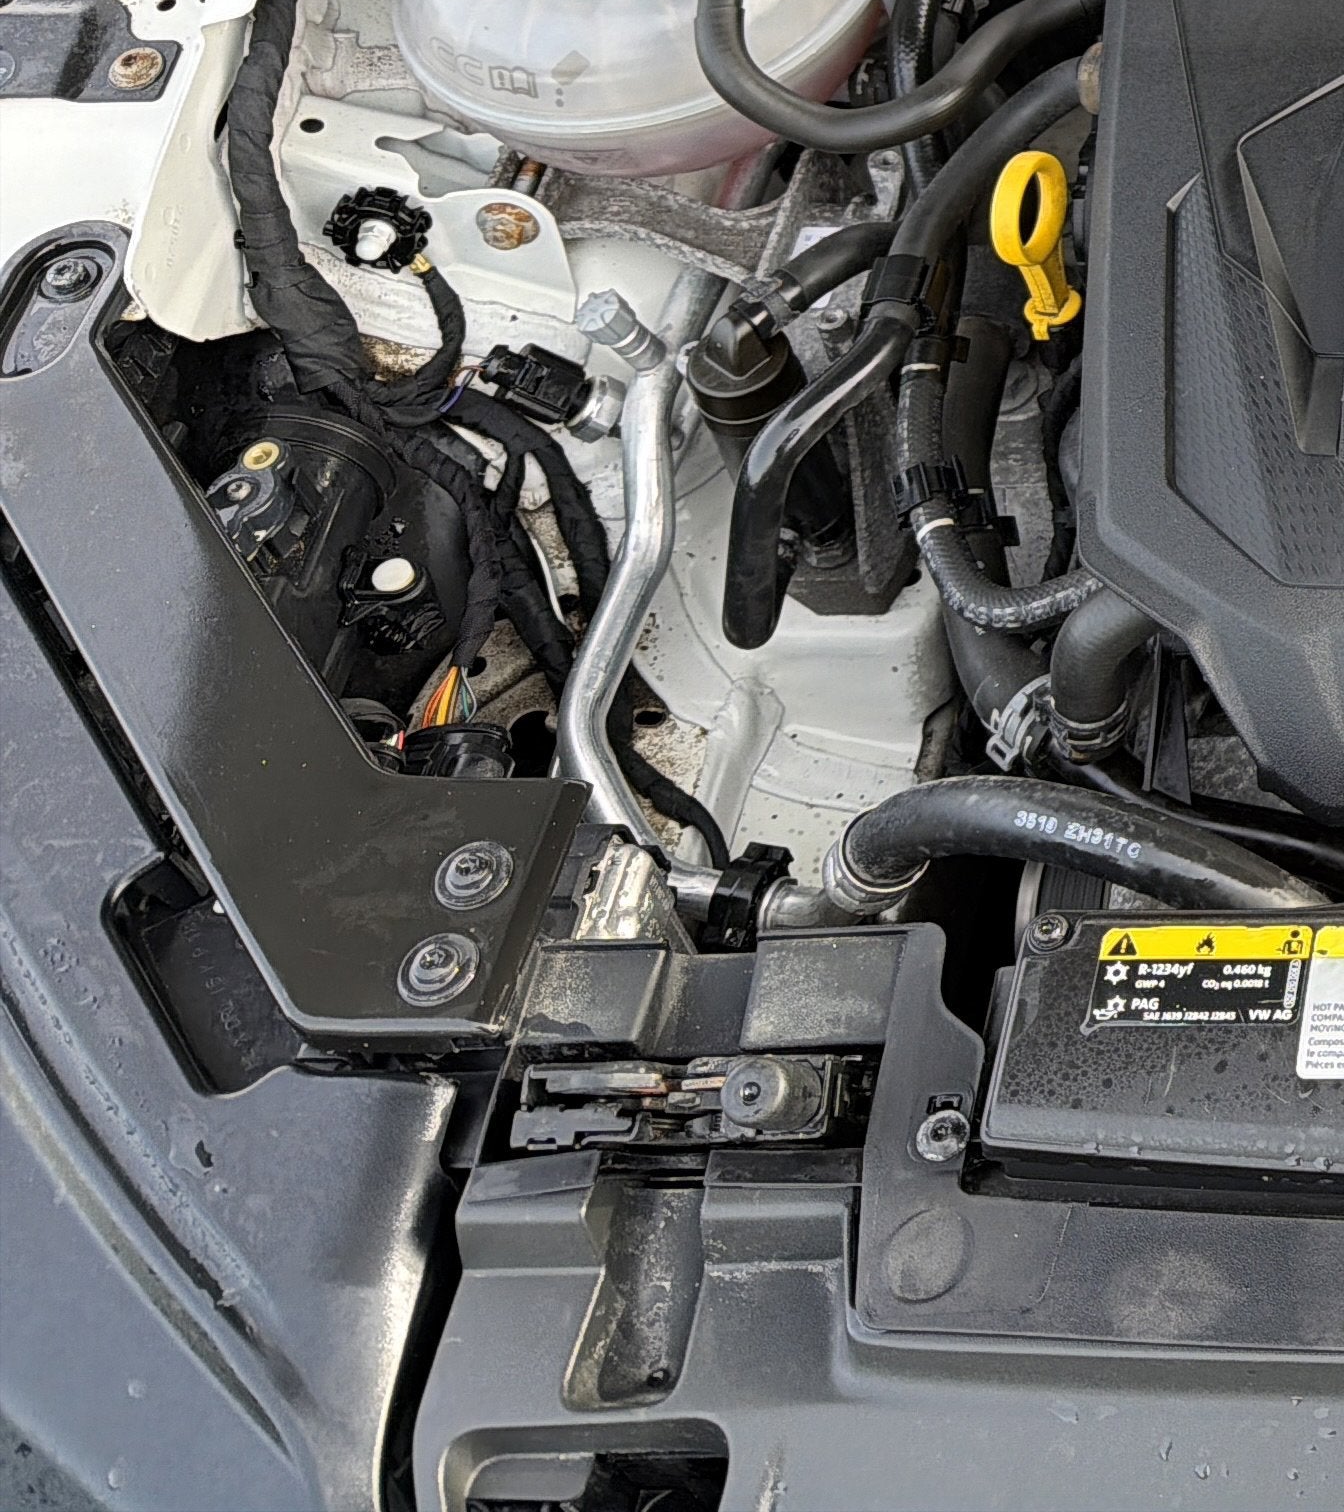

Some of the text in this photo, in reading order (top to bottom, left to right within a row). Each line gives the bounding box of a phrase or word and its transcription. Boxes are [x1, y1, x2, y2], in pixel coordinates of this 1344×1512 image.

[1138, 961, 1194, 978] R-1234yf
[1223, 965, 1272, 976] 0.460 kg
[1135, 980, 1165, 988] GWP 4
[1131, 998, 1160, 1010] PAG
[1313, 1003, 1331, 1011] HOT
[1249, 1009, 1292, 1020] VW AG
[1306, 1049, 1315, 1057] le
